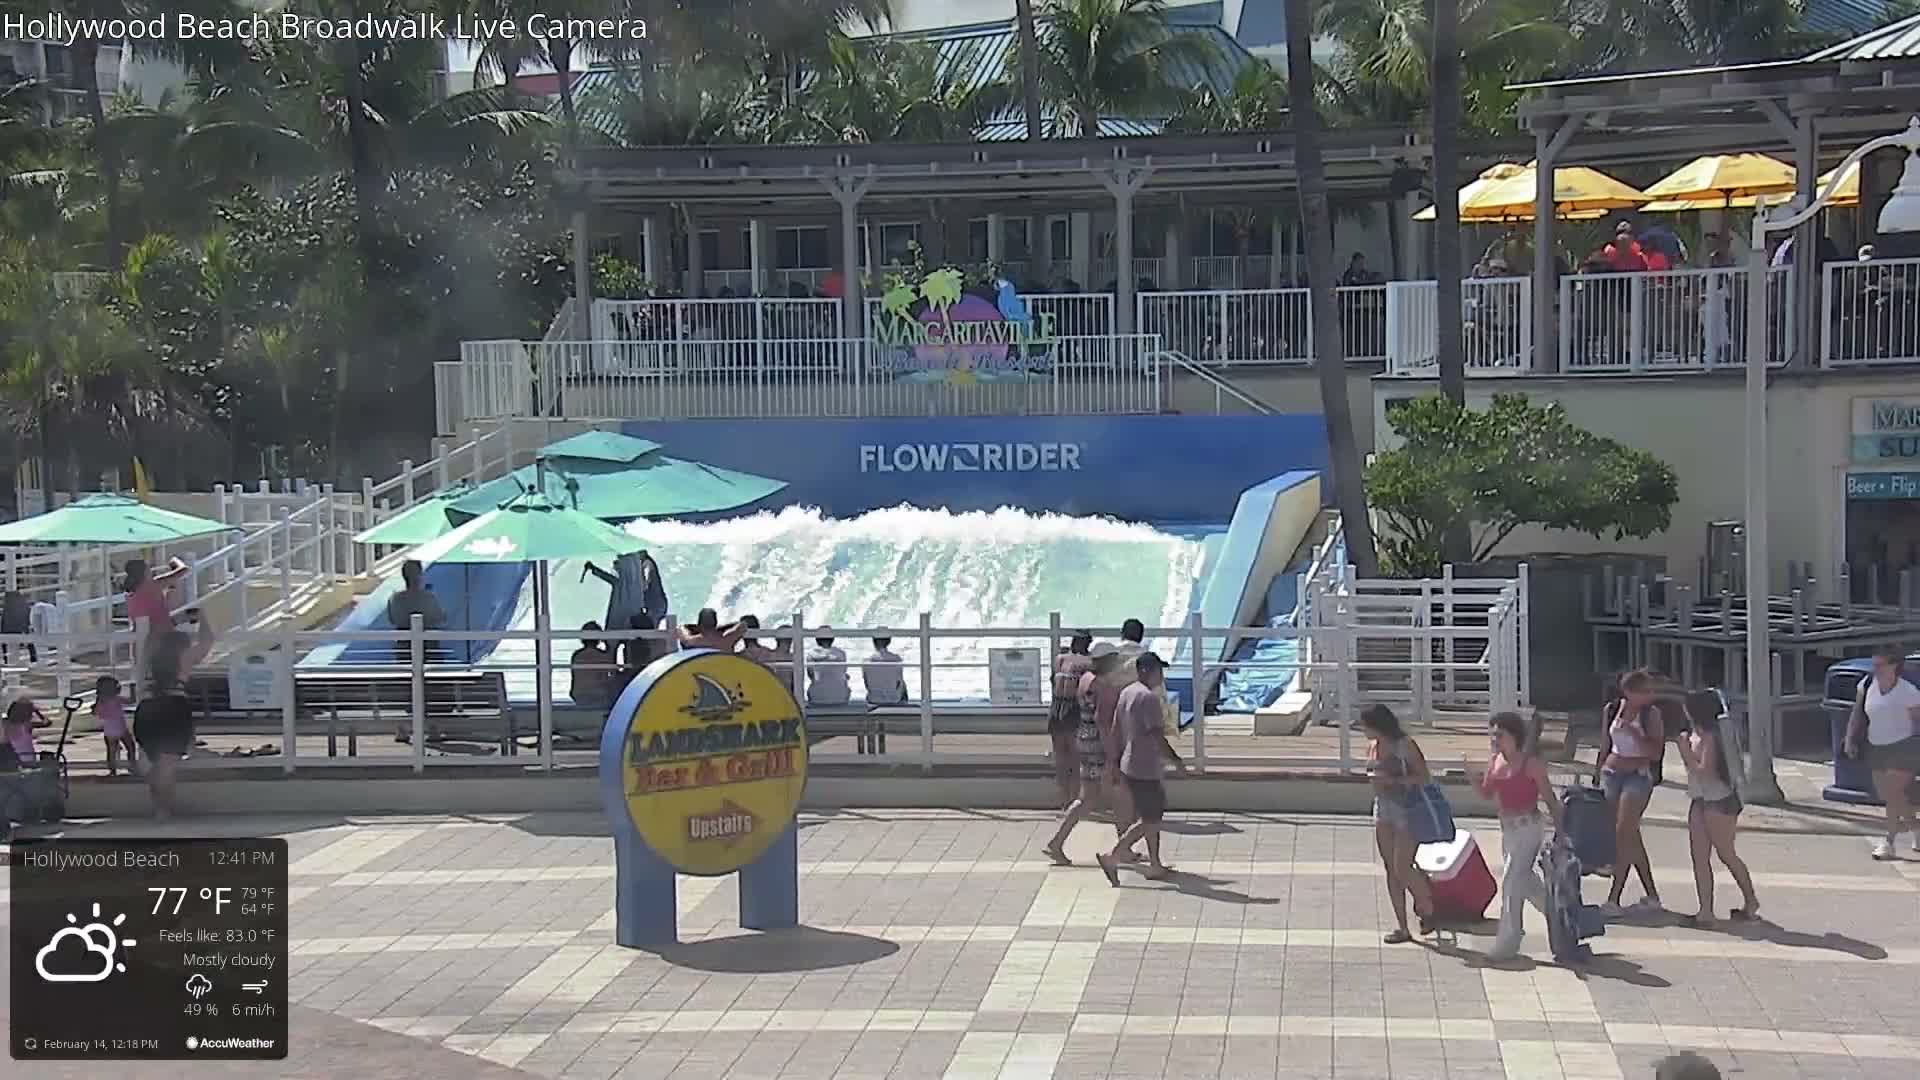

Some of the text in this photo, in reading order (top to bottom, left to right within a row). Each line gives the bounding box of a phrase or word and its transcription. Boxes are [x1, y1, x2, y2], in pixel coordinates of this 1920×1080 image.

[859, 443, 1081, 472] FLOW RIDER
[1847, 475, 1917, 497] Beer Flip
[630, 717, 802, 767] LANDSHARK
[689, 813, 752, 840] Upstairs
